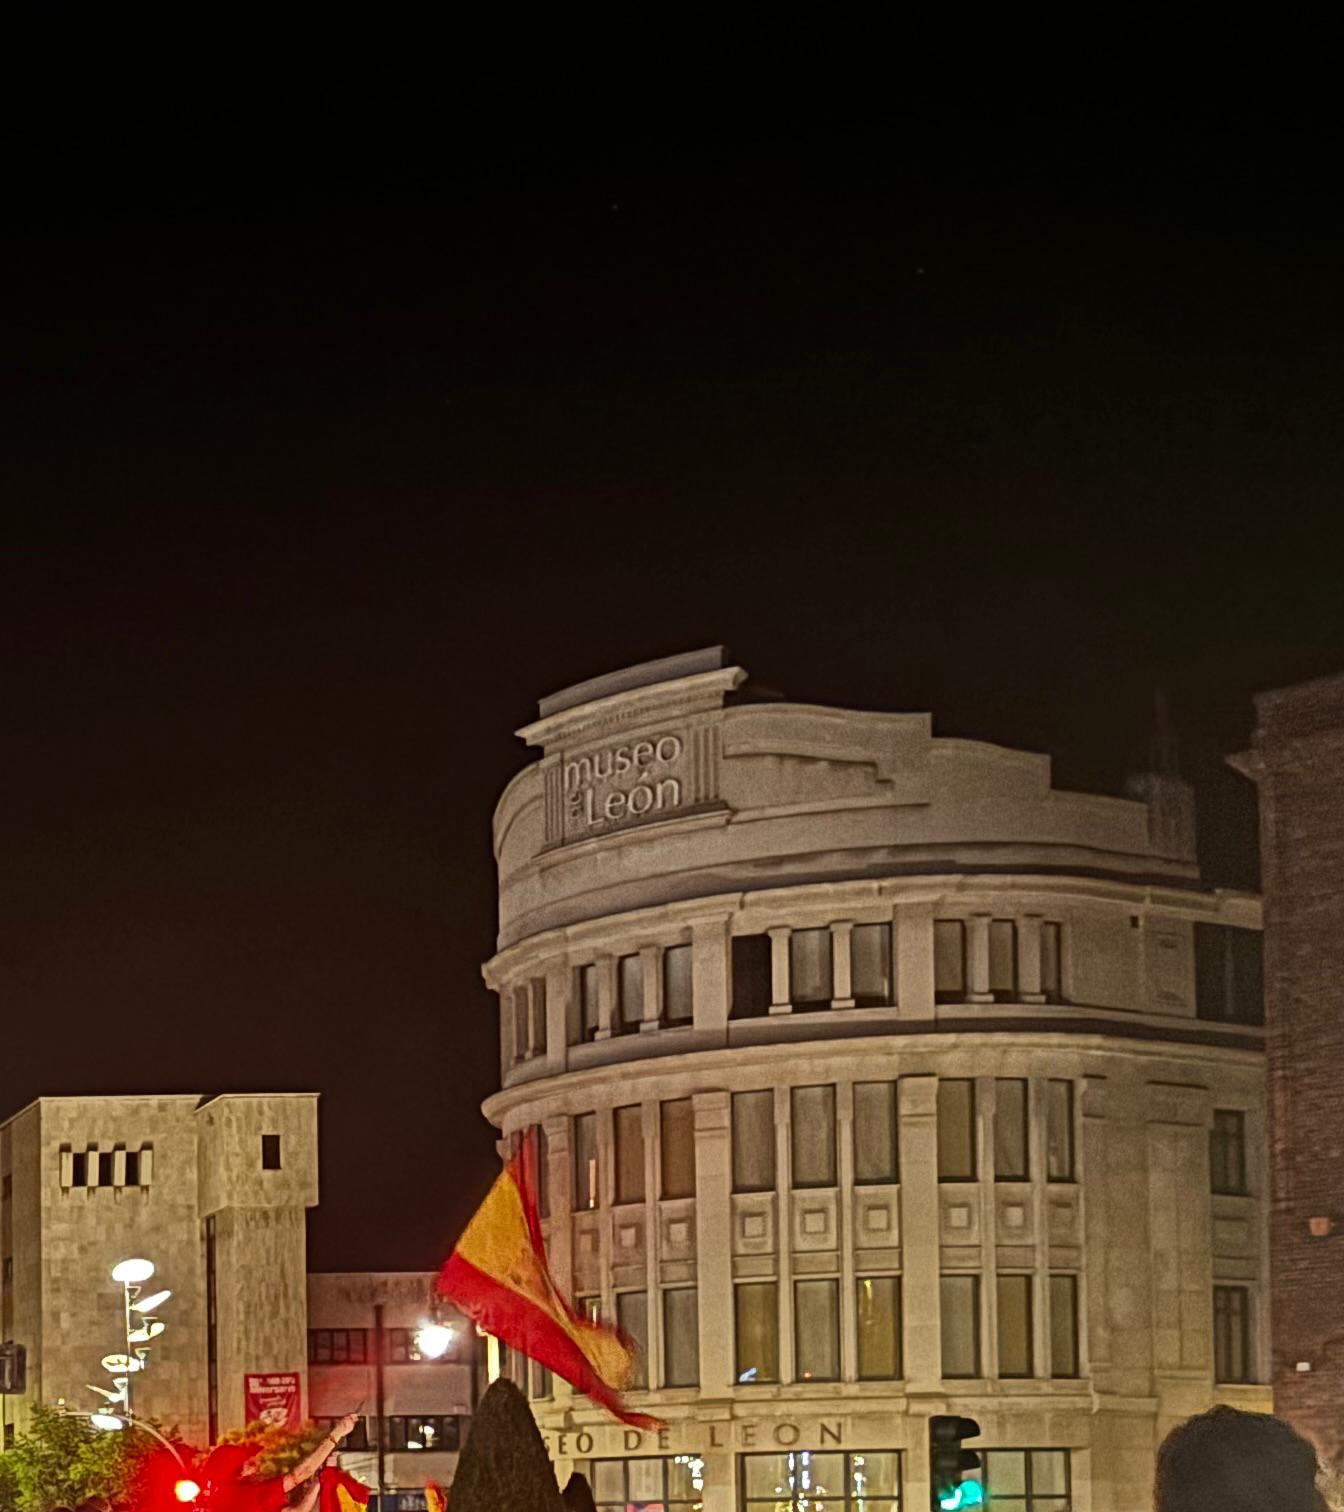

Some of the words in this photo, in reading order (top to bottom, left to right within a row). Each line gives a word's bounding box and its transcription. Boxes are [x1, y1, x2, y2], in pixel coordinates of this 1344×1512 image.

[564, 736, 682, 792] museo
[586, 771, 680, 825] León
[624, 1427, 669, 1451] DE
[709, 1422, 842, 1448] LEON
